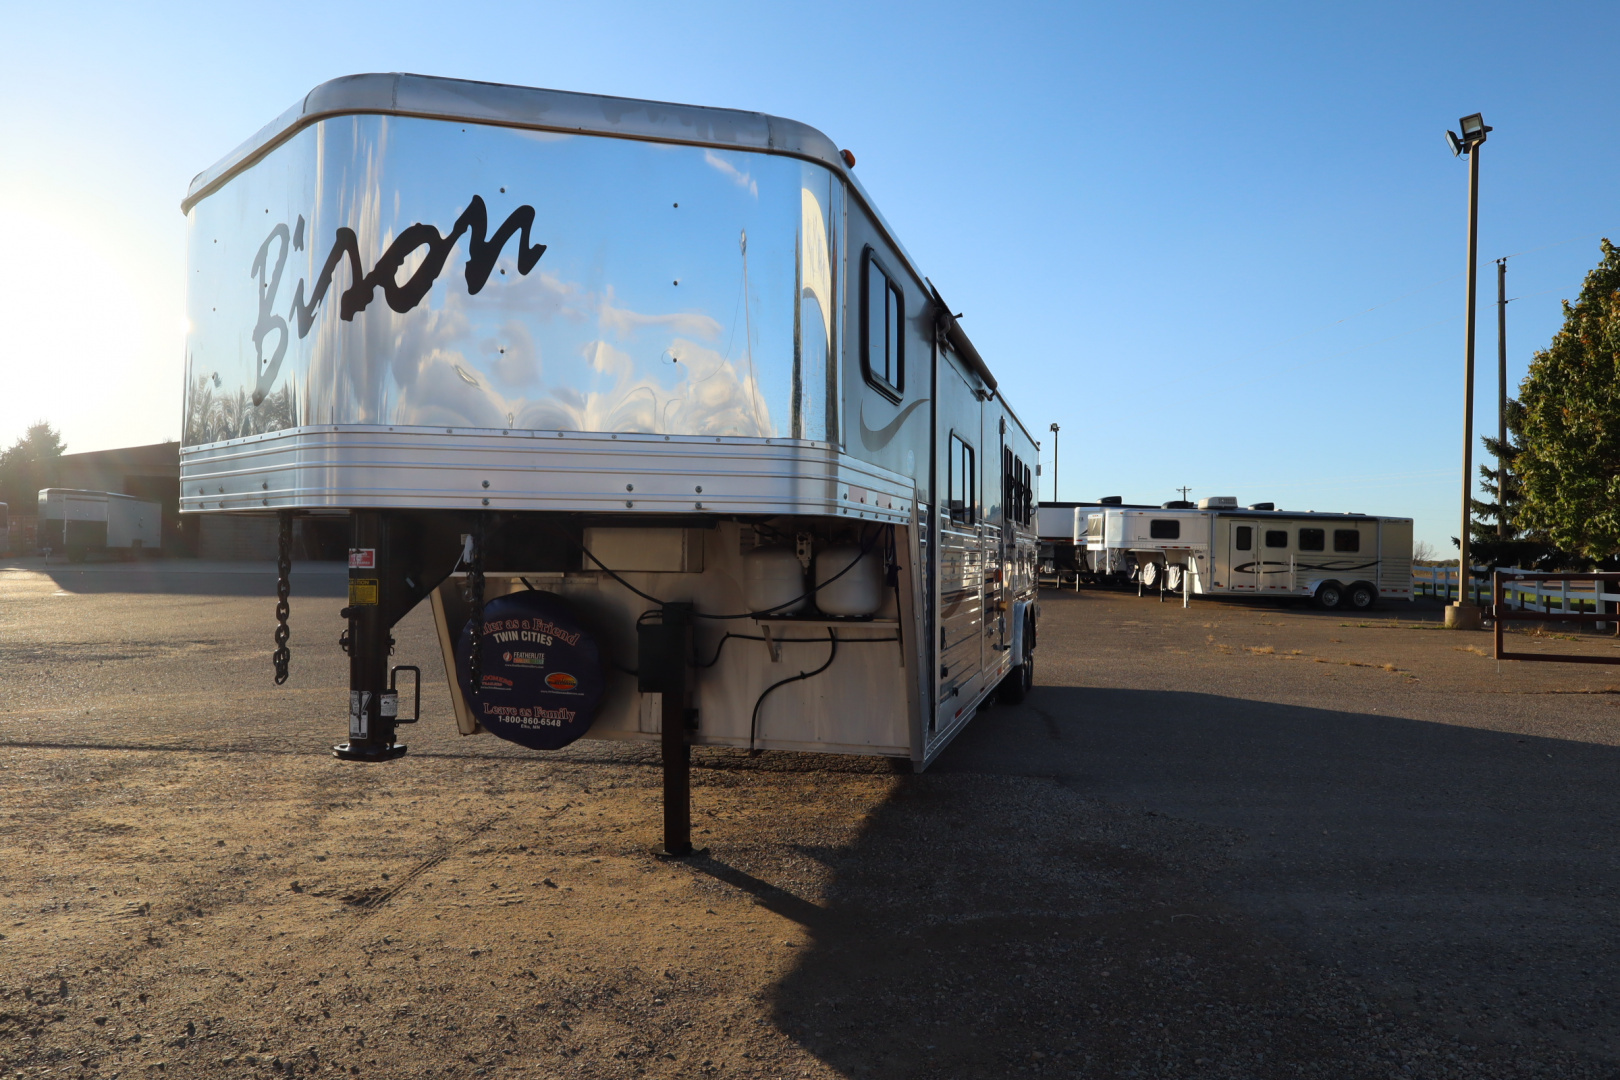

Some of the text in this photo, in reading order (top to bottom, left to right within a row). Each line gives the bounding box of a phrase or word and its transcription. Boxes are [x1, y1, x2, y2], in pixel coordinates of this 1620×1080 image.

[251, 194, 547, 407] Bison
[482, 618, 580, 646] ter as a Friend
[492, 630, 553, 647] TWIN CITIES
[483, 702, 576, 723] Leave as Family
[498, 715, 561, 728] 1-800-860-6548
